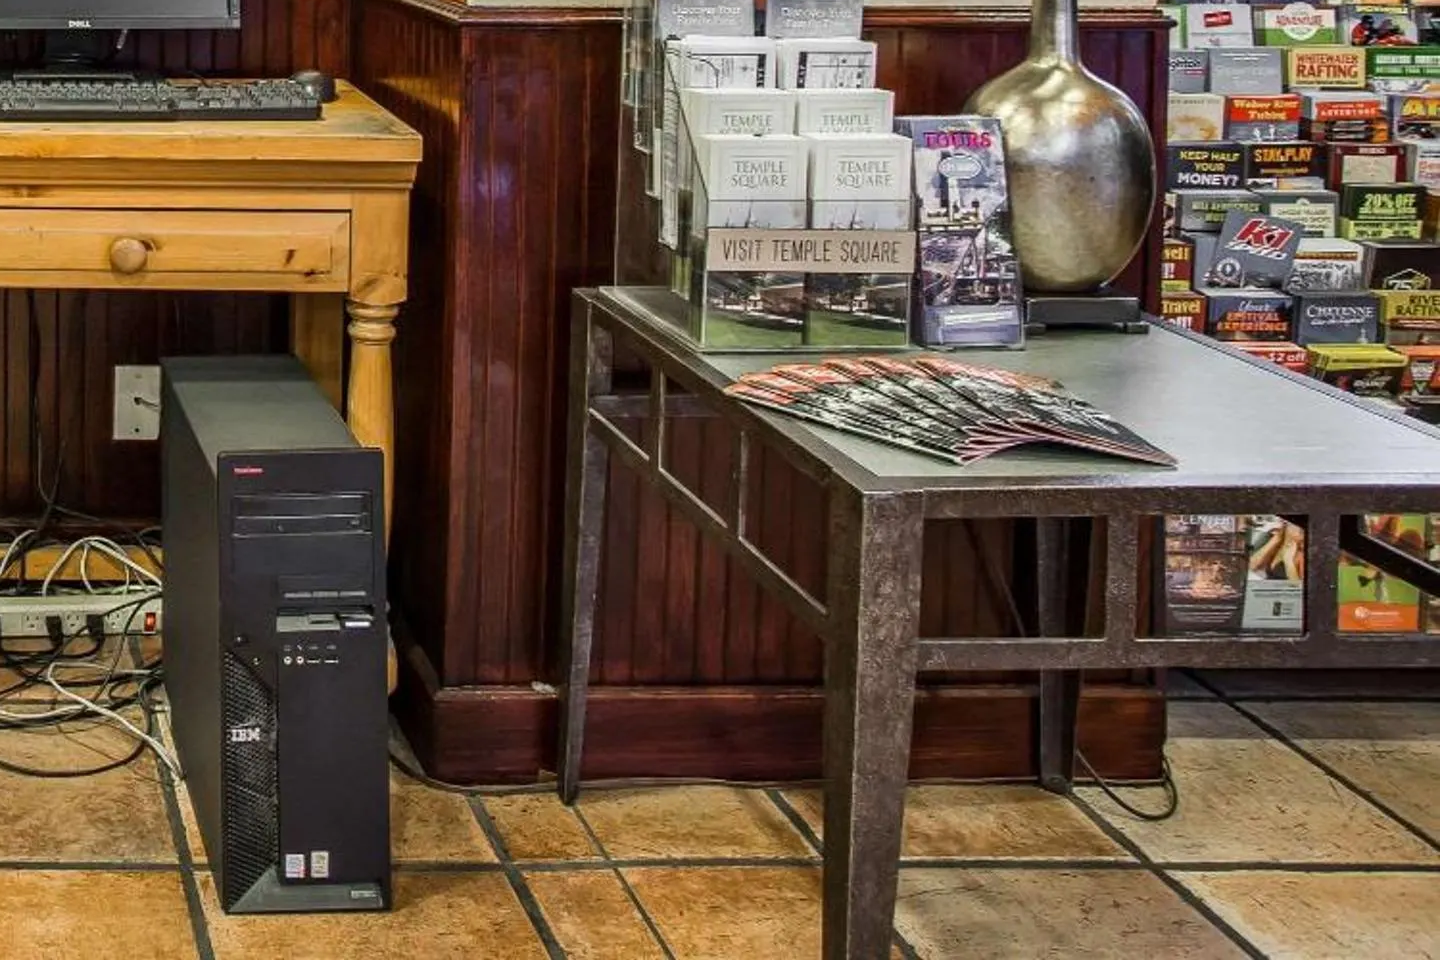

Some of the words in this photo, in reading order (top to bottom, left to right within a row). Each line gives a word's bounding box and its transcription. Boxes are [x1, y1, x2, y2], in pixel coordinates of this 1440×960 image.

[68, 20, 91, 28] DELL
[1296, 54, 1359, 64] WHITEWATER
[1296, 65, 1358, 78] RAFTING
[722, 115, 772, 126] TEMPLE
[823, 115, 870, 126] TEMPLE
[1180, 150, 1209, 160] KEEP
[1211, 151, 1240, 161] HALF
[735, 161, 787, 173] TEMPLE
[838, 161, 890, 173] TEMPLE
[1194, 162, 1226, 172] YOUR
[731, 176, 788, 189] SQUARE
[836, 176, 892, 189] SQUARE
[1178, 172, 1239, 186] MONEY?
[1363, 194, 1393, 208] 20%
[1395, 194, 1417, 208] OFF
[723, 240, 760, 261] VISIT
[772, 240, 831, 262] TEMPLE
[840, 240, 902, 264] SQUARE
[231, 728, 260, 741] IBM
